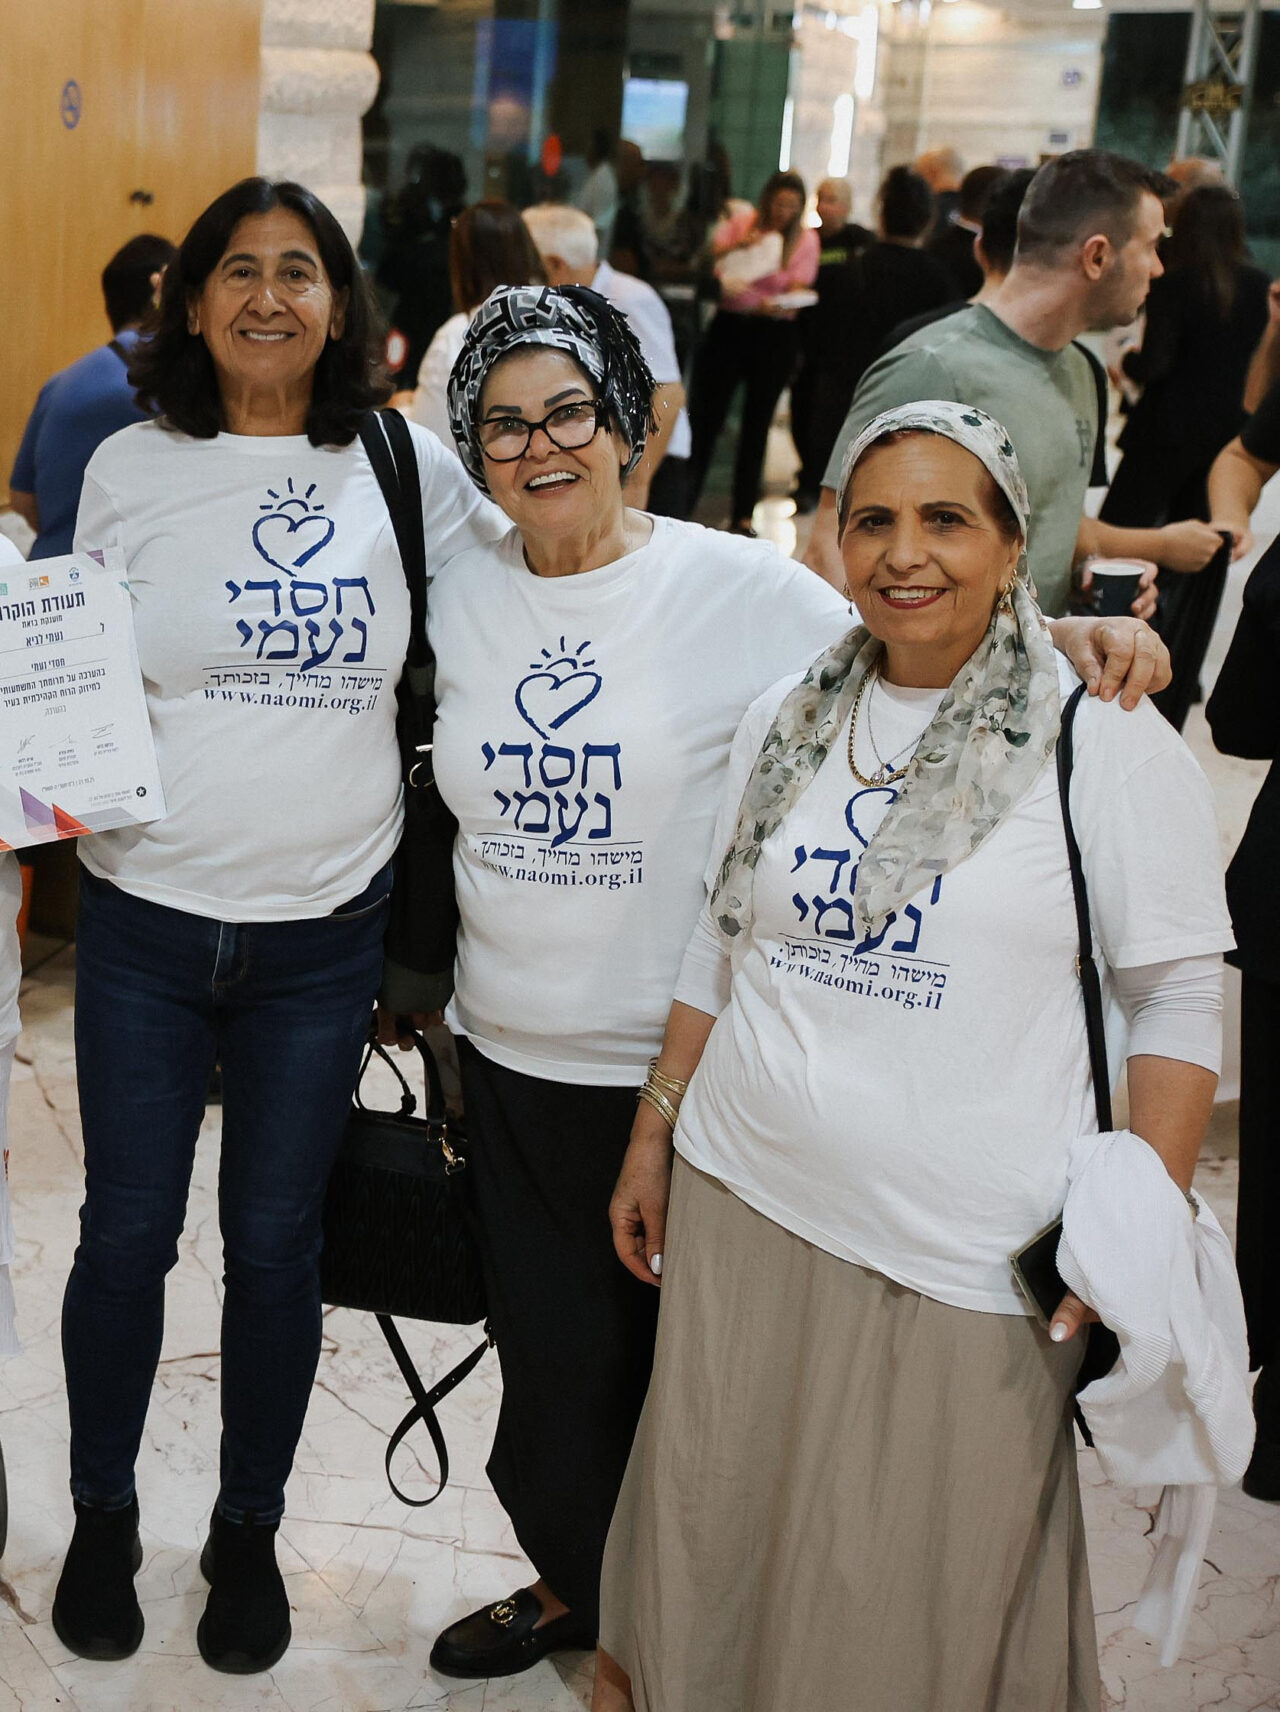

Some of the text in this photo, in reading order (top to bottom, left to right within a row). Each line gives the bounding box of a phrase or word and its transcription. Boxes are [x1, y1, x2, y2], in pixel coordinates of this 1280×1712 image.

[41, 591, 86, 613] תעודת
[225, 576, 376, 617] חסדי
[22, 614, 63, 629] מוענקת בזאת
[25, 633, 44, 647] לביא
[236, 617, 367, 672] נעמי
[48, 658, 66, 668] חסדי
[78, 668, 106, 680] בהערכה
[66, 674, 76, 682] על
[341, 674, 383, 691] מישהו
[204, 689, 378, 715] www.naomi.org.il
[481, 741, 623, 790] חסדי
[493, 789, 612, 849] נעמי
[590, 850, 643, 866] מישהו
[792, 892, 922, 956] נעמי
[891, 964, 947, 988] מישהו
